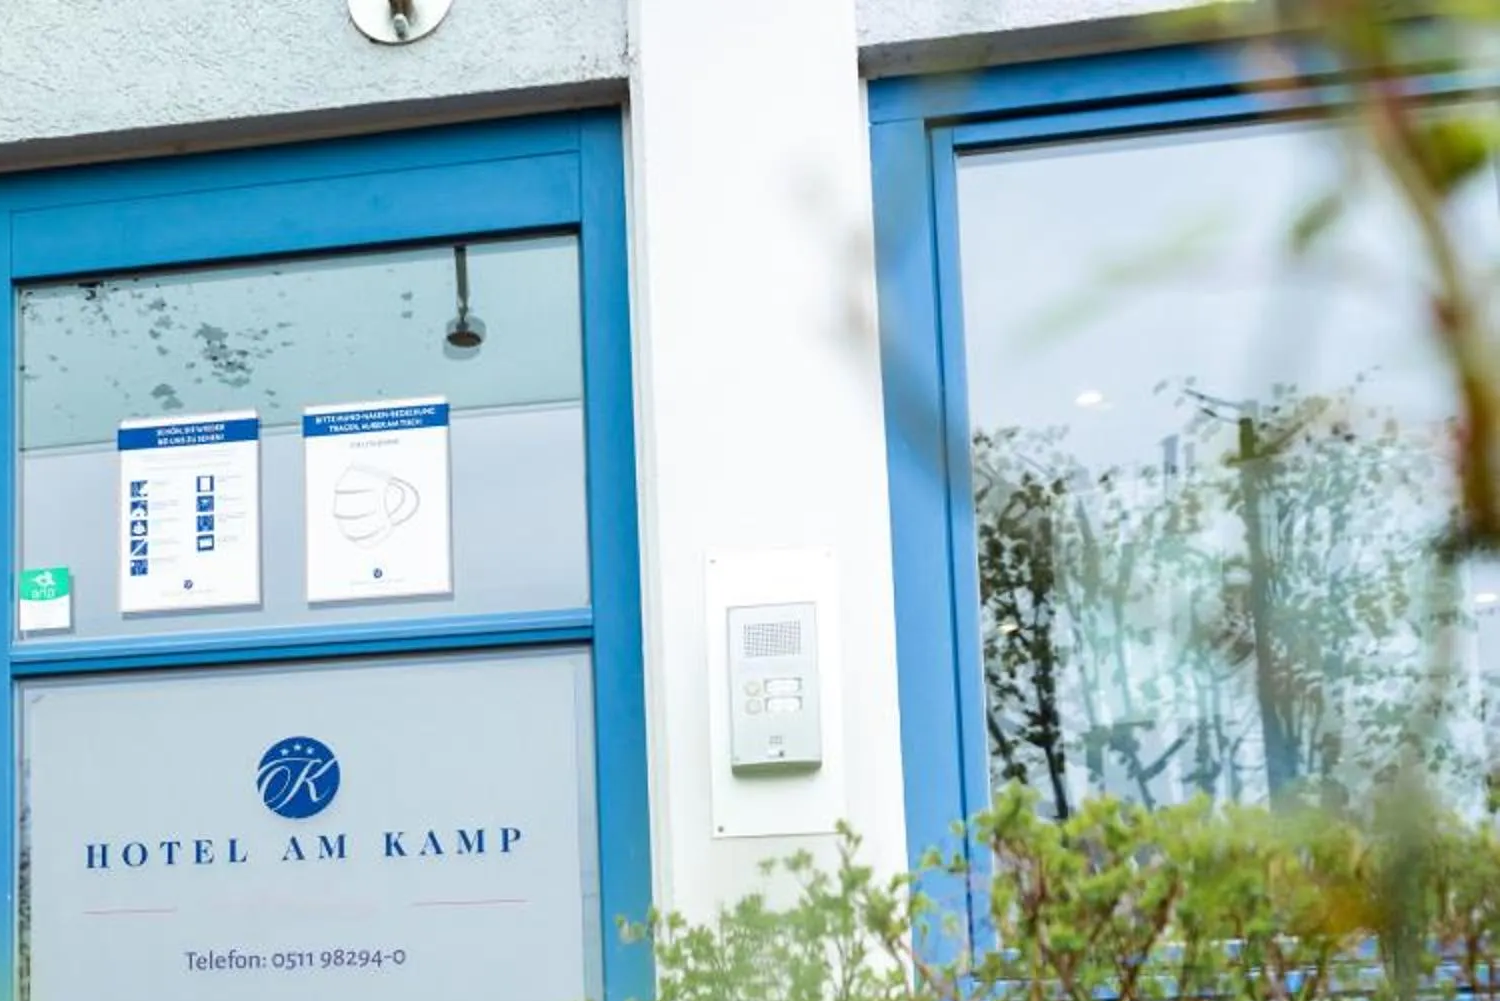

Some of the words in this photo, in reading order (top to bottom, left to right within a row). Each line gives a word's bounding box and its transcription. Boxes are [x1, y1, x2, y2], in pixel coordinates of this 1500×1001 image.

[86, 838, 249, 869] HOTEL
[282, 834, 347, 861] AM
[384, 827, 522, 857] KAMP
[185, 949, 268, 971] Telefon:
[272, 952, 313, 970] 0511
[320, 948, 407, 968] 98294-0
